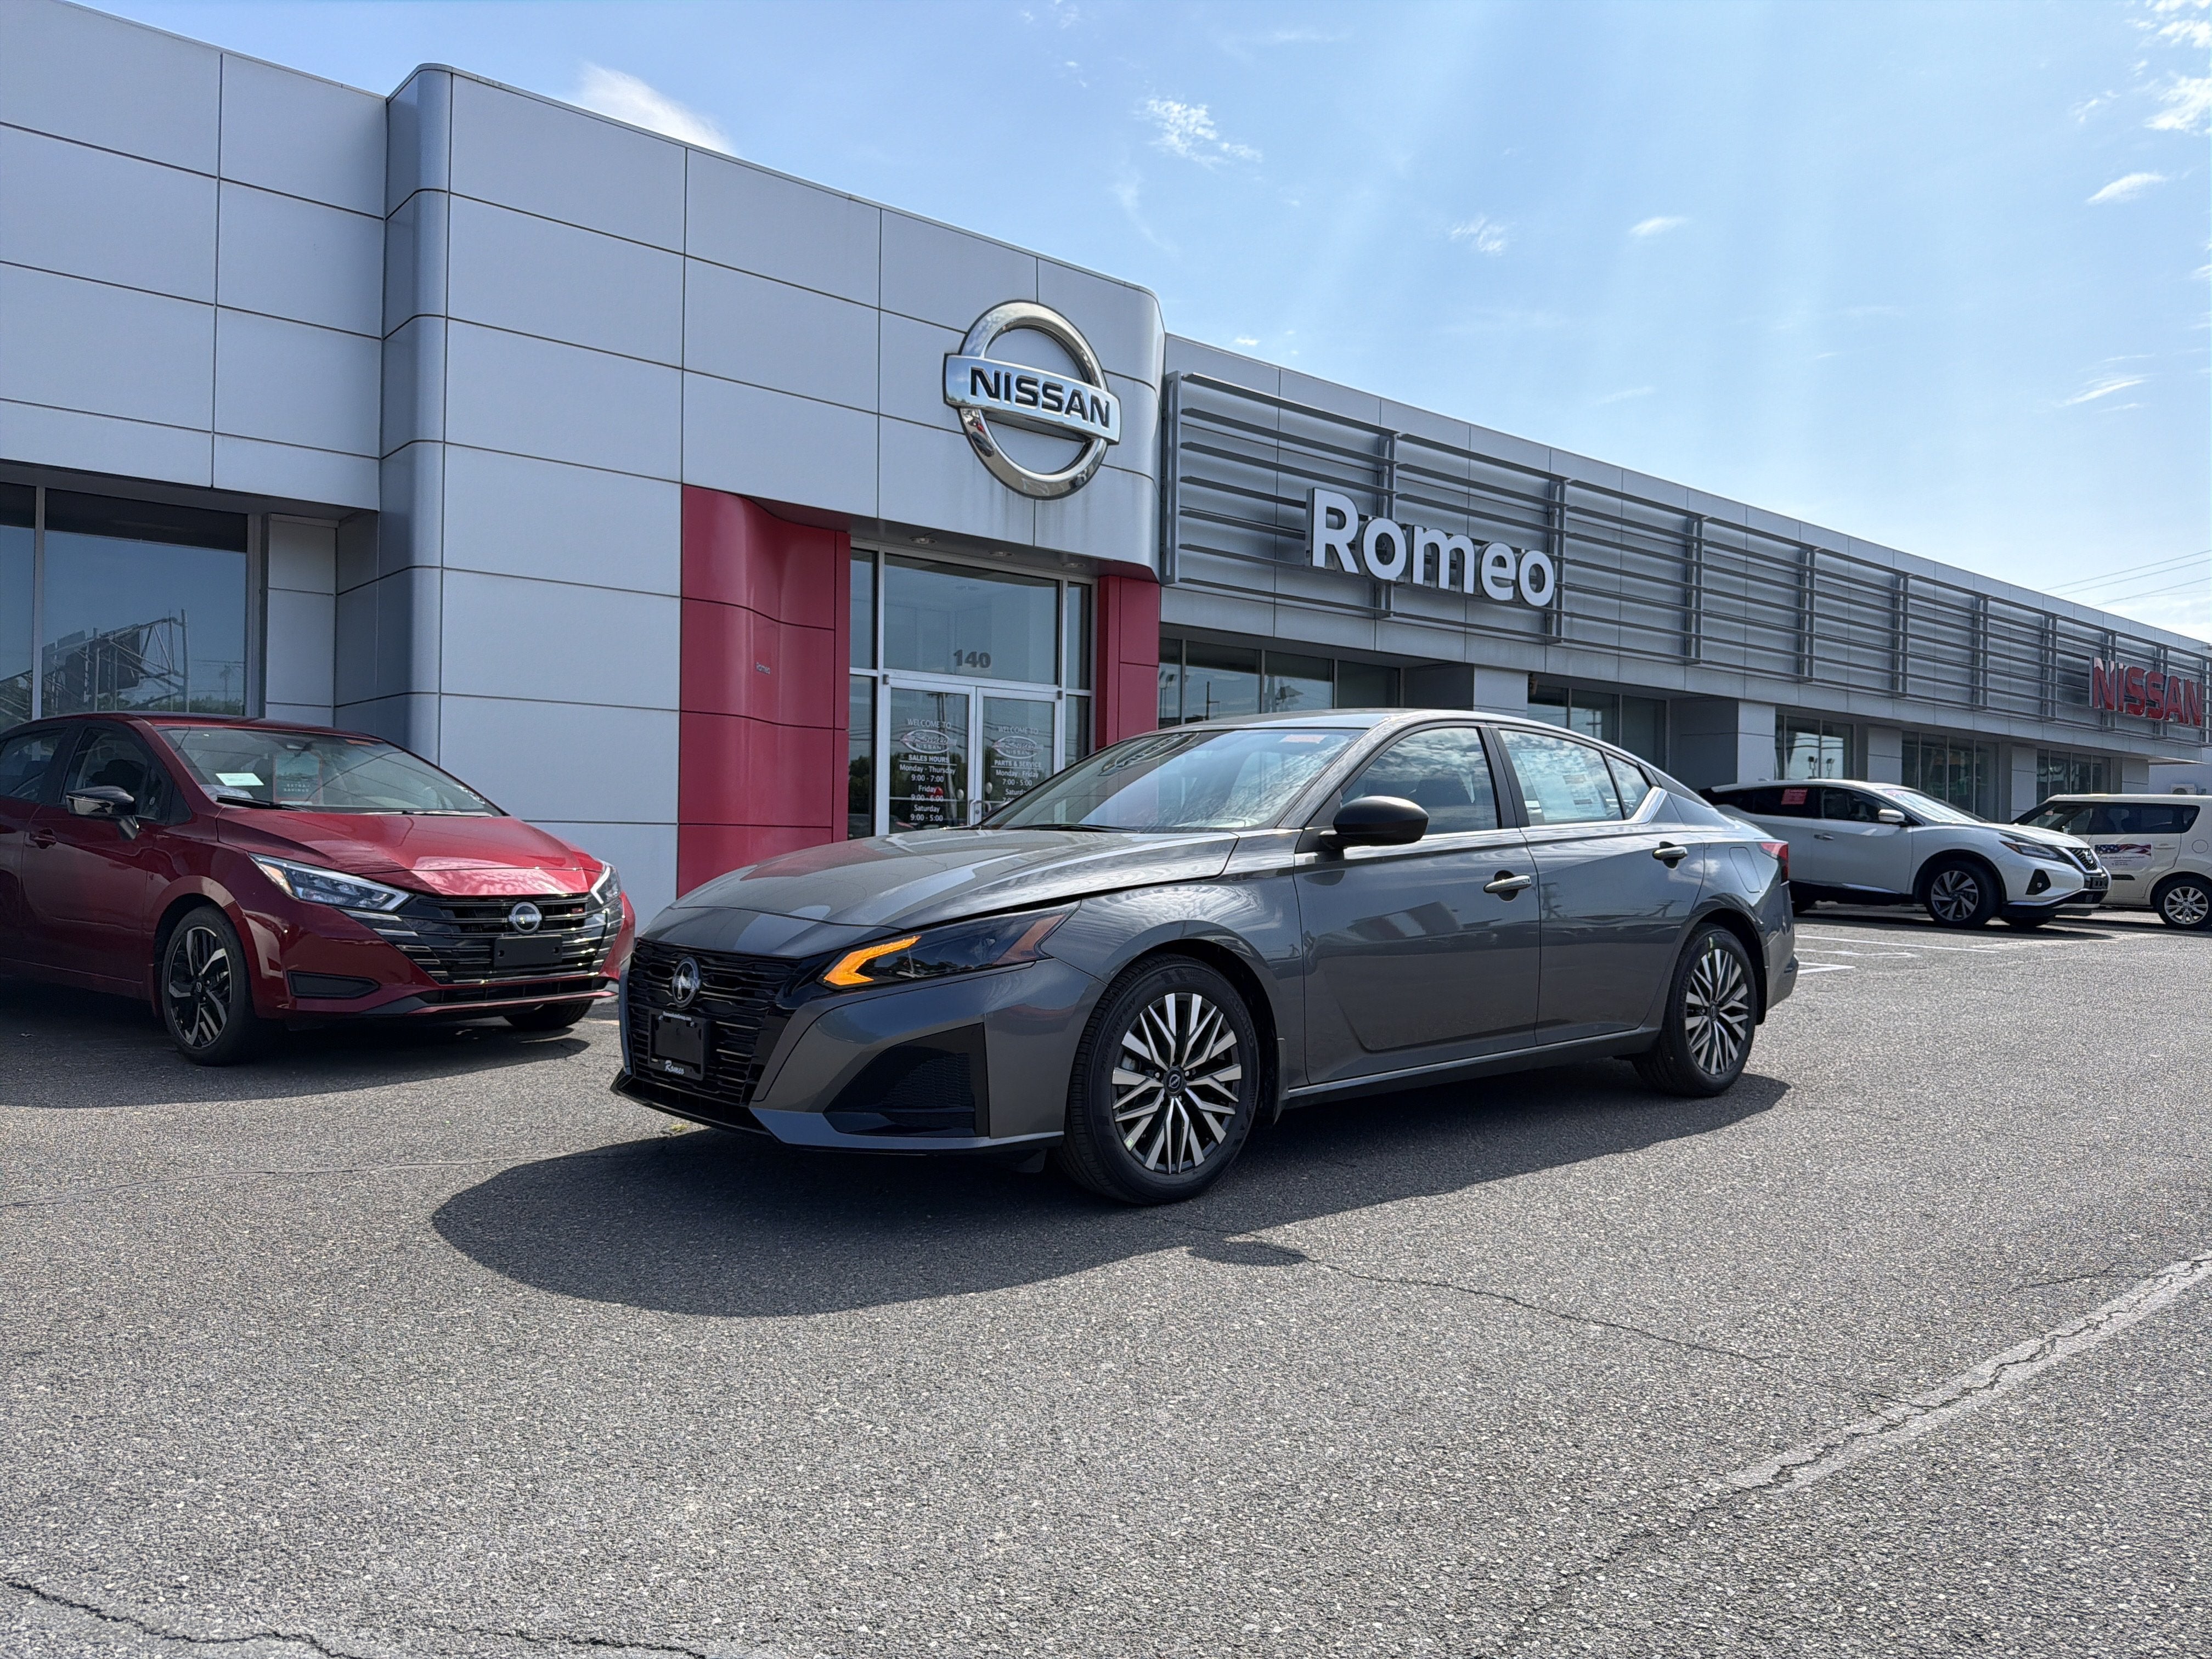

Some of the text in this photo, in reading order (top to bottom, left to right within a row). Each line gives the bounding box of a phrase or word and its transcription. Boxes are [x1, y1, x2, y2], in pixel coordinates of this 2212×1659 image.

[970, 367, 1110, 429] NISSAN
[1309, 487, 1555, 607] Romeo
[953, 649, 991, 668] 140
[2091, 658, 2203, 727] NISSAN
[907, 719, 941, 729] WELCOME
[998, 726, 1028, 734] WELCOME
[900, 764, 923, 773] Monday
[929, 766, 956, 775] Thursday
[996, 770, 1018, 778] Monday
[914, 804, 940, 813] Saturday
